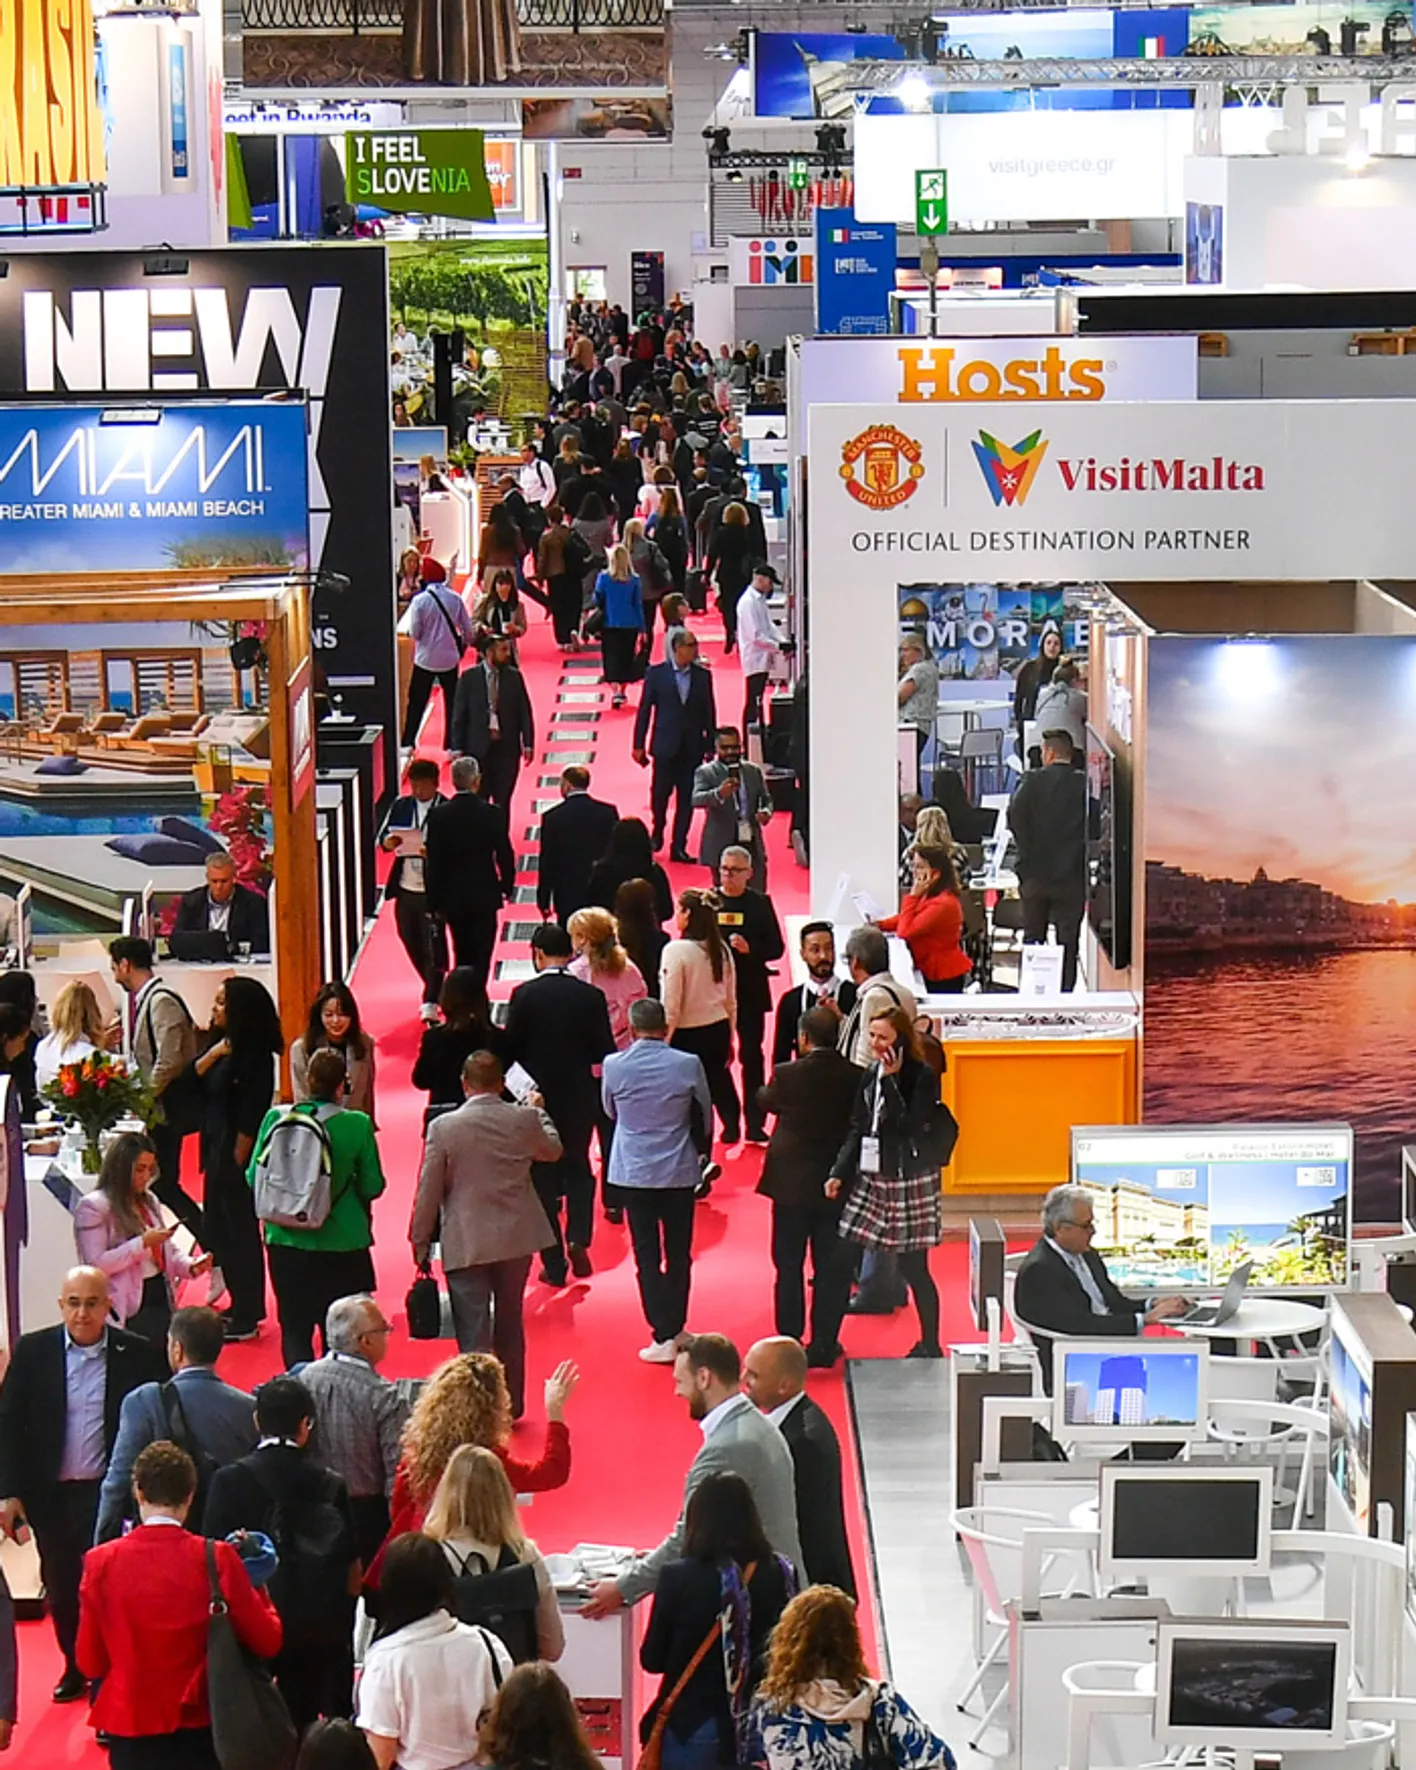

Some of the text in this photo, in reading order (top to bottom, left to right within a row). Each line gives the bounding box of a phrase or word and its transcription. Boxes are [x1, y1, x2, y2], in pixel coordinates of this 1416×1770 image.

[355, 136, 426, 163] I FEEL
[988, 155, 1115, 178] visitgreece.gr
[358, 167, 471, 194] SLOVENIA
[23, 287, 342, 396] NEW
[897, 346, 1105, 403] Hosts
[846, 430, 917, 460] MANCHESTER
[0, 424, 263, 496] MIAMI
[1057, 457, 1264, 491] VisitMalta
[73, 503, 124, 518] MIAMI
[129, 503, 141, 518] &
[146, 502, 197, 517] MIAMI
[203, 501, 264, 517] BEACH
[858, 490, 906, 506] UNITED
[852, 529, 1250, 551] OFFICIAL DESTINATION PARTNER
